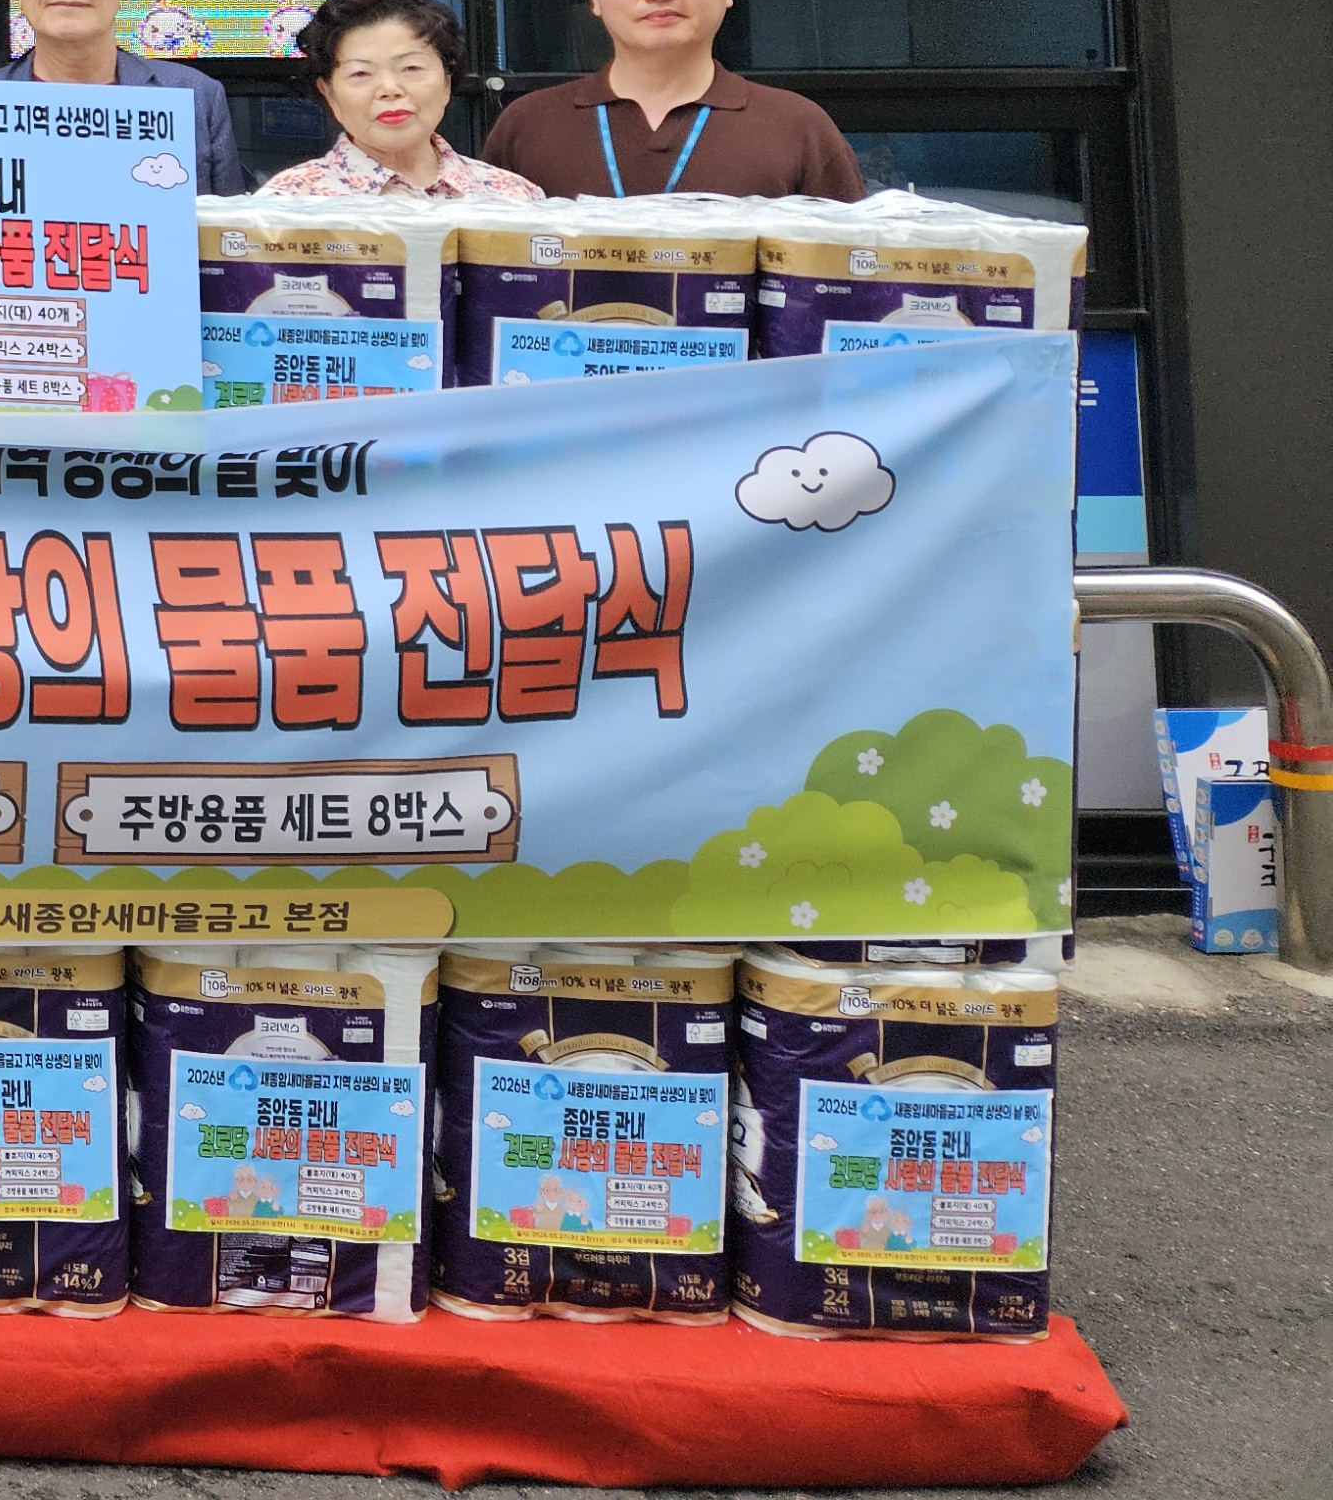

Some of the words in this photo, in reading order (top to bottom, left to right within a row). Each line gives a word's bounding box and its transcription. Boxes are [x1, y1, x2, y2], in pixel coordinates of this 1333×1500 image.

[13, 104, 50, 136] 지역
[55, 106, 110, 139] 상생의
[115, 109, 133, 140] 날
[138, 110, 174, 141] 맞이
[44, 220, 149, 293] 전달식
[37, 307, 70, 323] 40개
[27, 341, 72, 358] 24박스
[17, 379, 38, 395] 세트
[42, 380, 72, 396] 8박스
[149, 525, 368, 732] 물품
[373, 519, 696, 725] 전달식
[119, 794, 267, 844] 주방용품
[280, 793, 353, 842] 세트
[367, 790, 465, 843] 8박스
[0, 902, 271, 934] 새종암새마을금고
[284, 901, 350, 933] 본점
